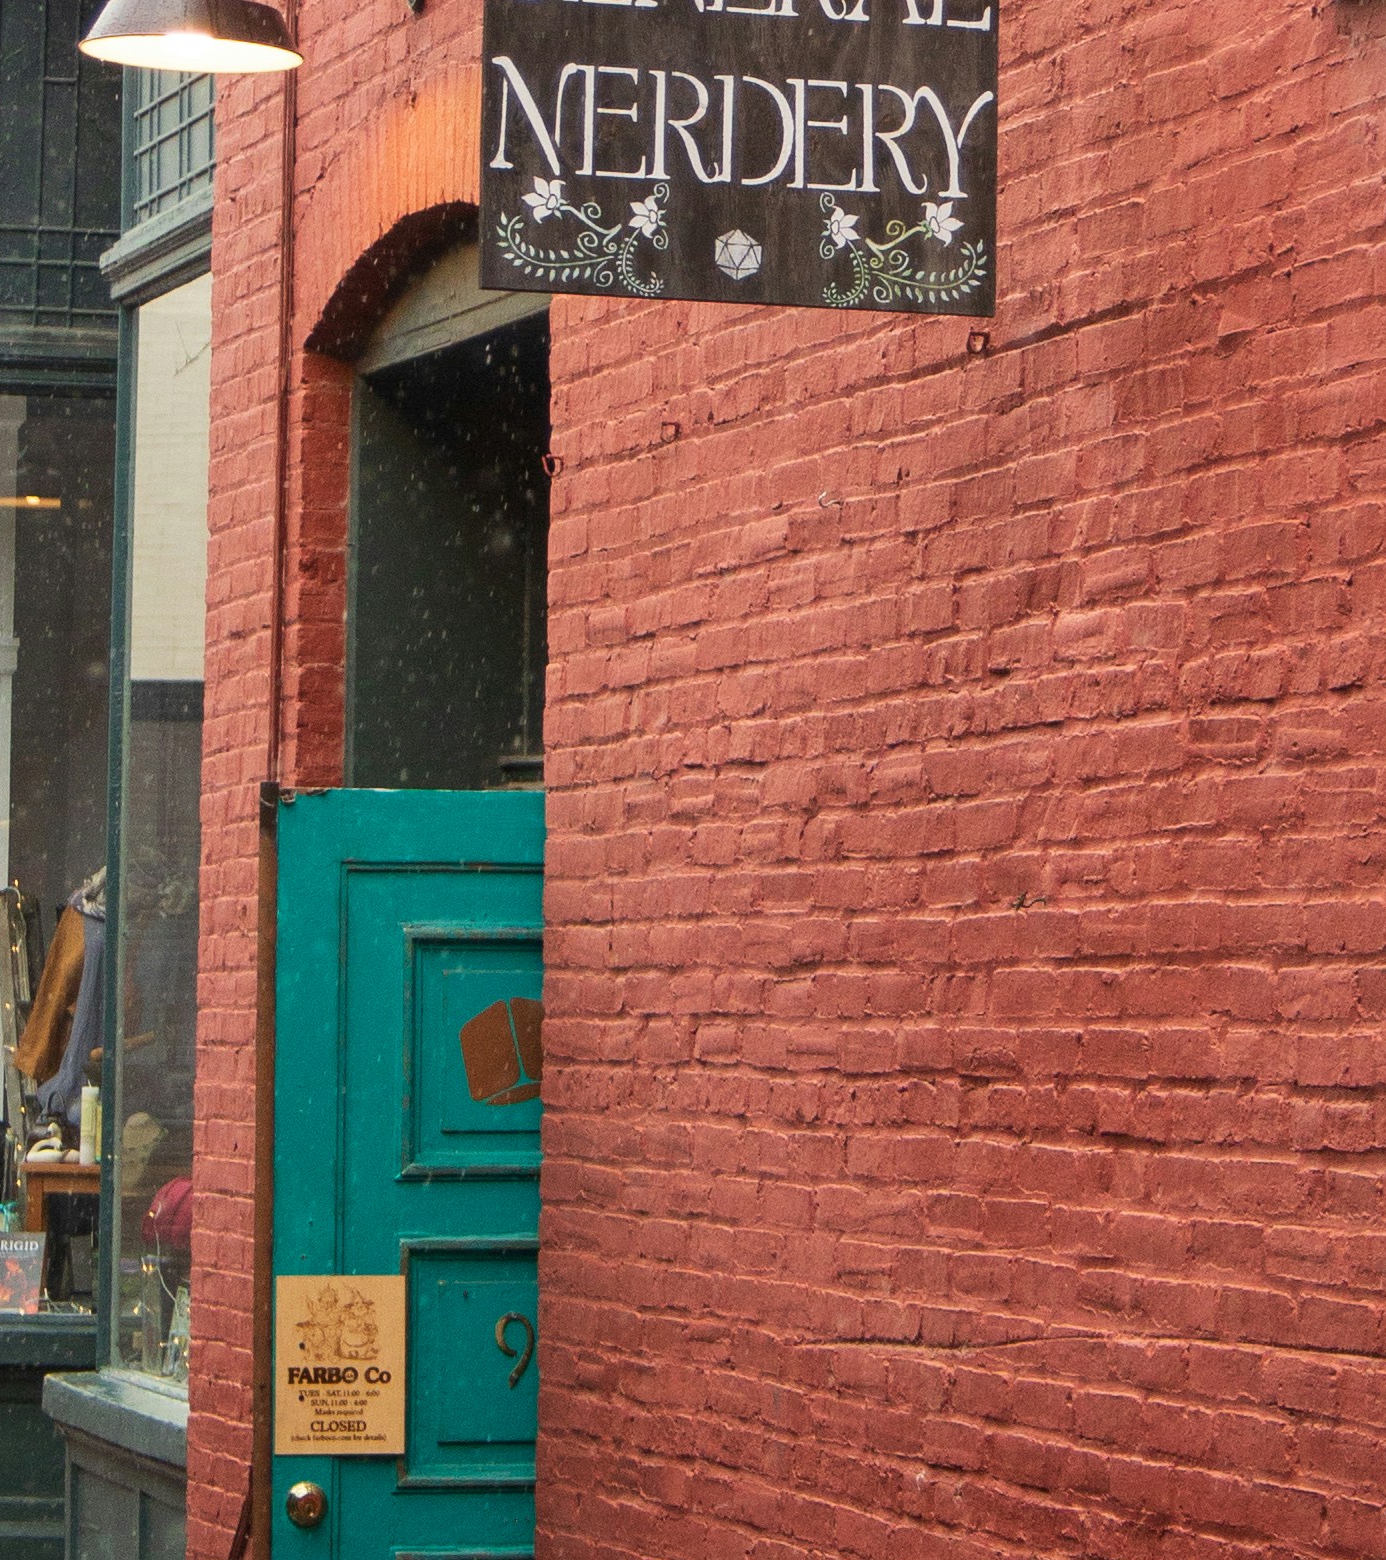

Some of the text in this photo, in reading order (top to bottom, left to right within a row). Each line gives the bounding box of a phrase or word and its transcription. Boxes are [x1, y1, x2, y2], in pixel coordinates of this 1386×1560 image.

[489, 55, 994, 199] NERDERY
[287, 1366, 392, 1384] FARBO Co
[310, 1420, 367, 1432] CLOSED
